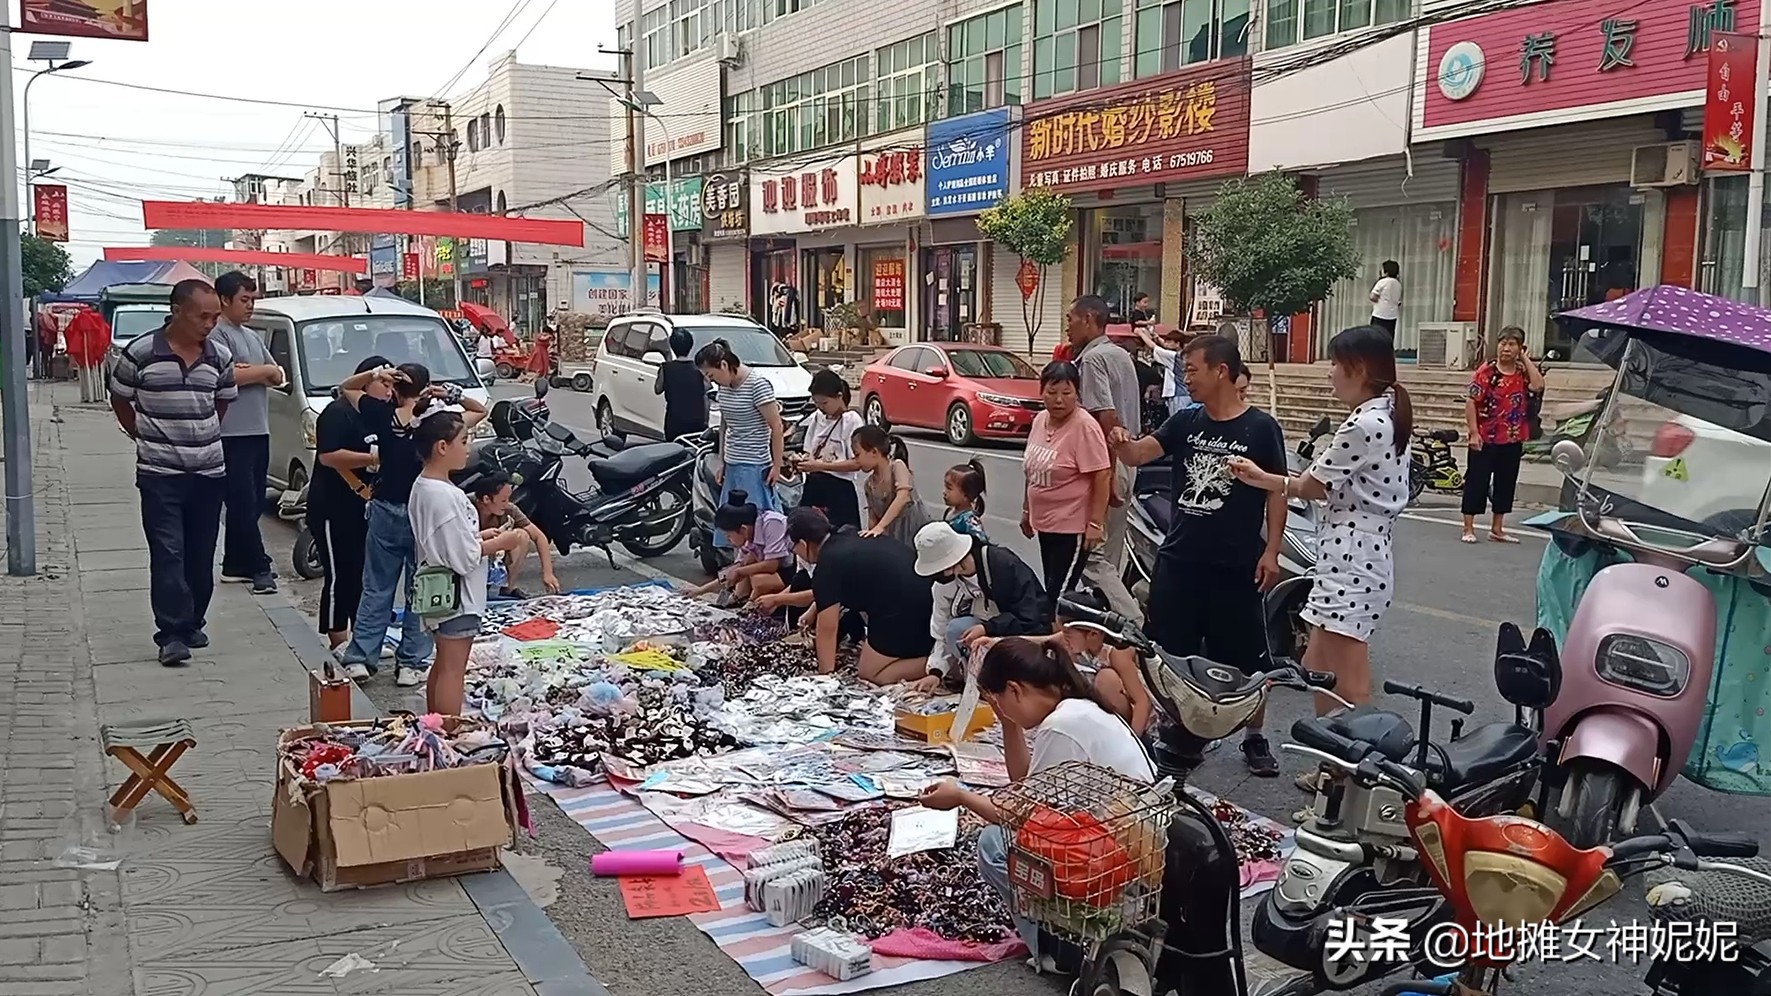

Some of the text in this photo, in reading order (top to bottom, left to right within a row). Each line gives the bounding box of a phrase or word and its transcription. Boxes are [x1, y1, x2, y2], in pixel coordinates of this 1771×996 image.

[1519, 0, 1738, 86] 养发师
[1719, 61, 1731, 103] 自由
[1029, 81, 1216, 161] 新时代婚纱影楼
[1730, 101, 1745, 143] 平等
[346, 145, 358, 193] 兴华旅社
[1029, 149, 1213, 187] 儿童写真 证件拍照 婚庆服务 电话 67519766
[705, 182, 740, 212] 美香园
[762, 167, 838, 214] 迎迎服饰
[1186, 430, 1207, 445] An
[1207, 435, 1228, 449] idea
[1228, 440, 1249, 453] tree
